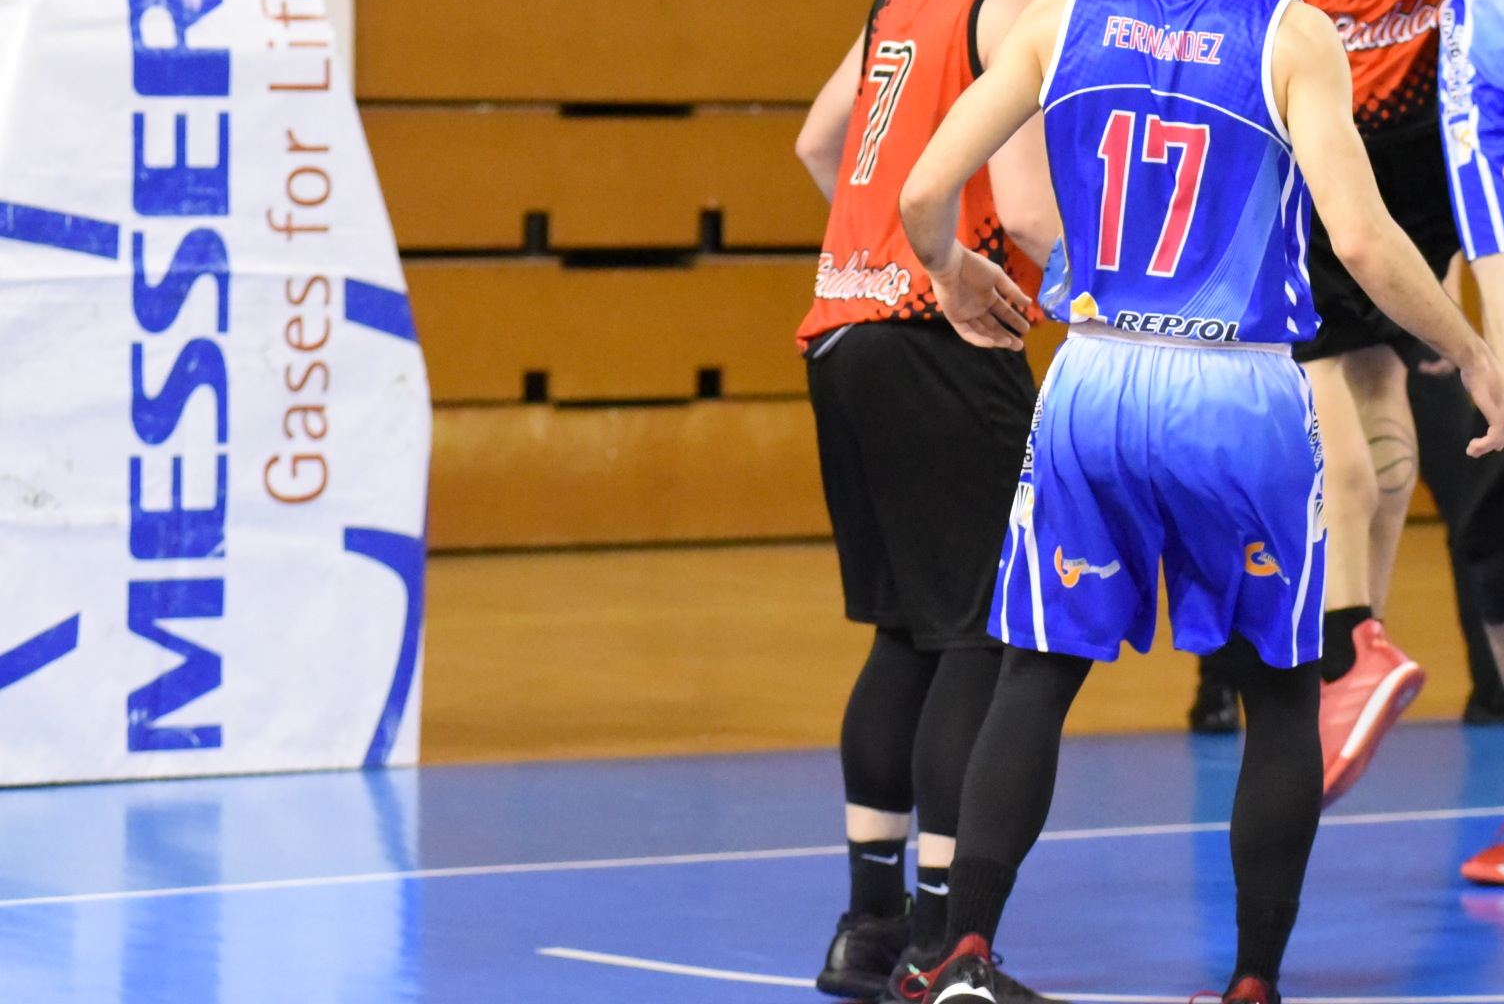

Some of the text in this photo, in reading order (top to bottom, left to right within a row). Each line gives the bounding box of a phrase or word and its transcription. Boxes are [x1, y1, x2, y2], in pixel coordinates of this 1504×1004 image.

[1103, 15, 1224, 65] FERNÁNDEZ
[849, 40, 916, 184] 7
[266, 128, 331, 241] for
[1096, 110, 1210, 278] 17
[264, 274, 332, 504] Gases
[1115, 311, 1240, 342] REPSOL
